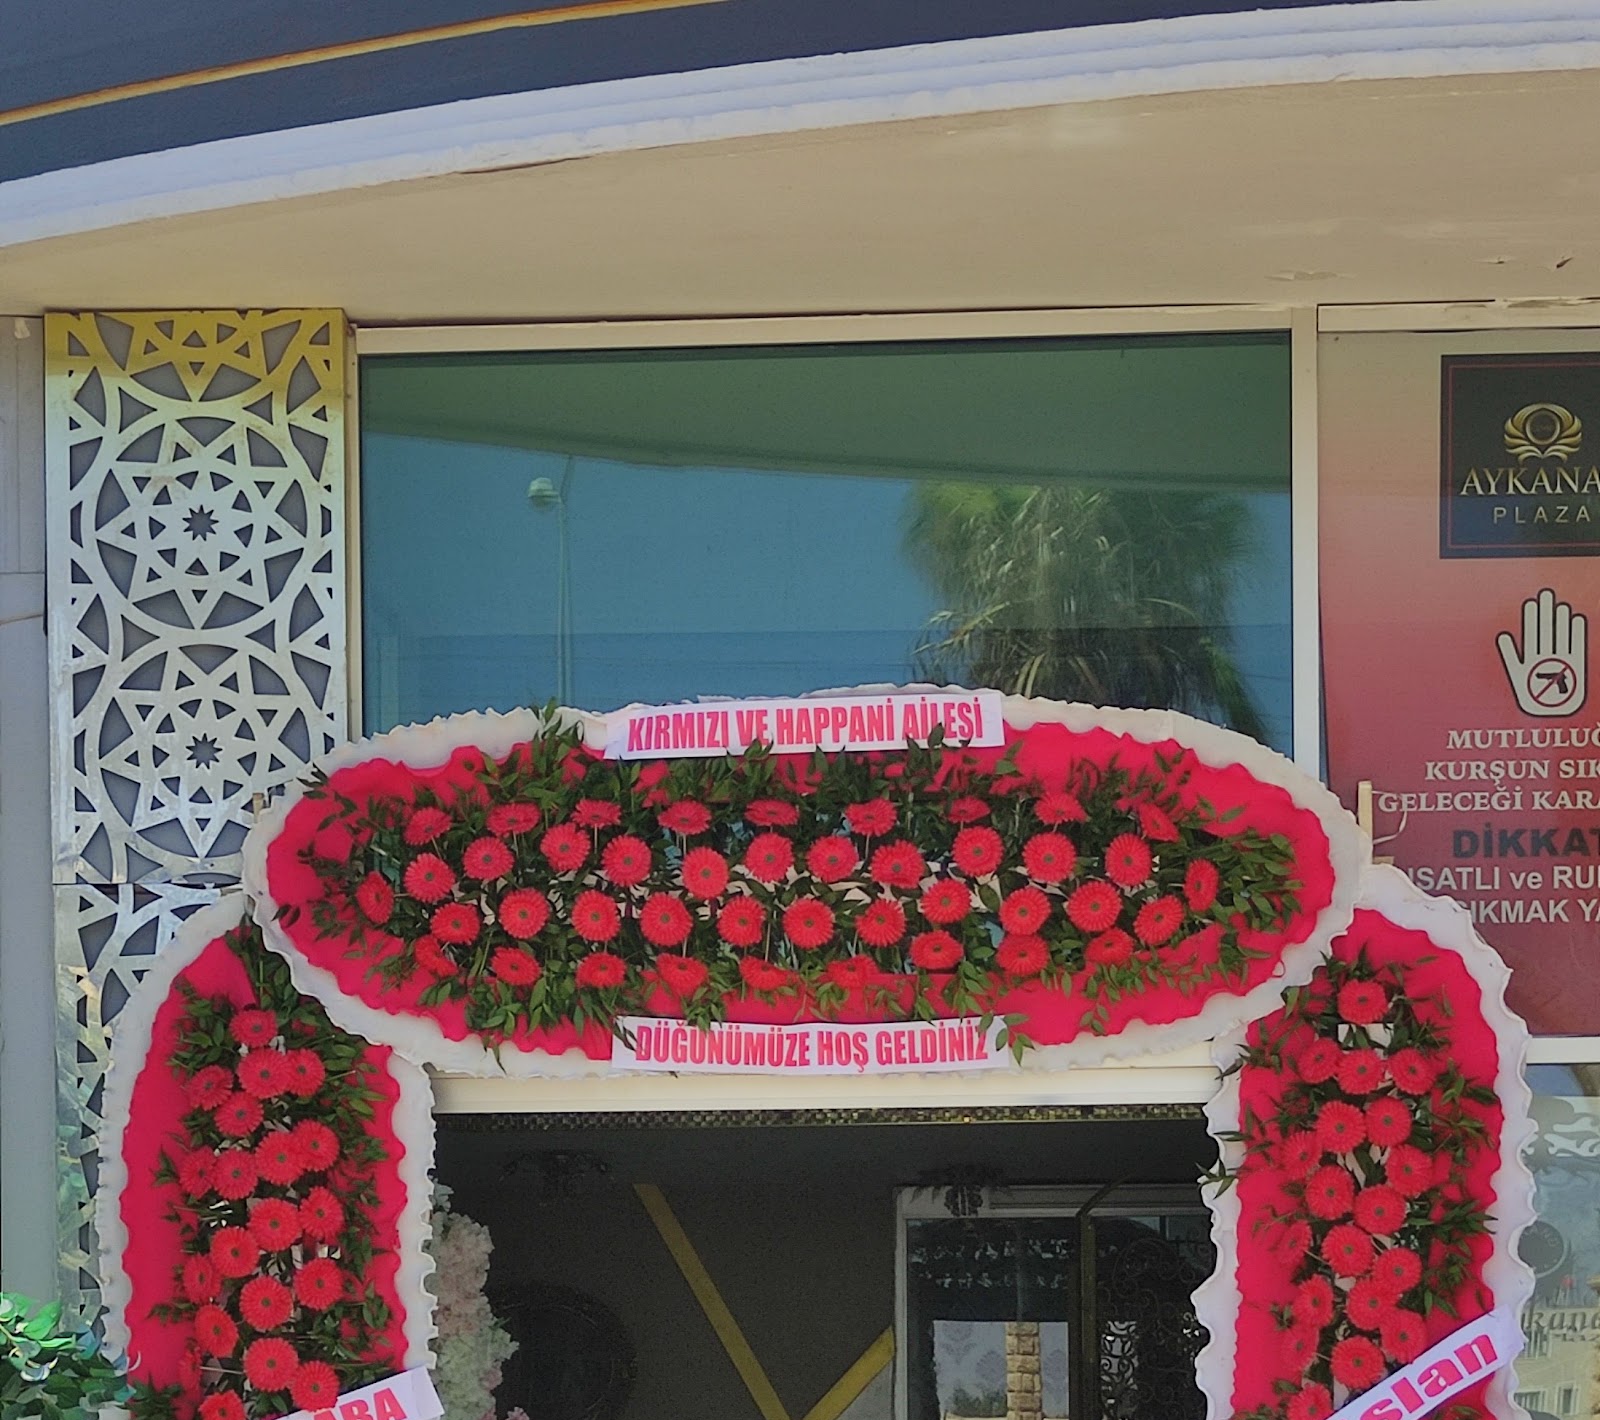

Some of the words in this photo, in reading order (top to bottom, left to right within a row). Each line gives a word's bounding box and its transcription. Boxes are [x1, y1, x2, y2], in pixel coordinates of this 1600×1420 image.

[1493, 504, 1591, 524] PLAZA
[627, 711, 730, 752] KIRMIZI
[736, 709, 769, 747] VE
[776, 697, 895, 745] HAPPANİ
[902, 696, 983, 740] AİLESİ
[1425, 759, 1550, 786] KURŞUN
[1378, 785, 1523, 812] GELECEĞİ
[1532, 789, 1600, 811] KAR
[1408, 866, 1500, 890] SATLI
[1510, 872, 1543, 890] ve
[1553, 865, 1600, 890] RU
[1458, 899, 1569, 924] IKMAK
[817, 1030, 870, 1073] HOŞ
[876, 1021, 988, 1066] GELDİNİZ
